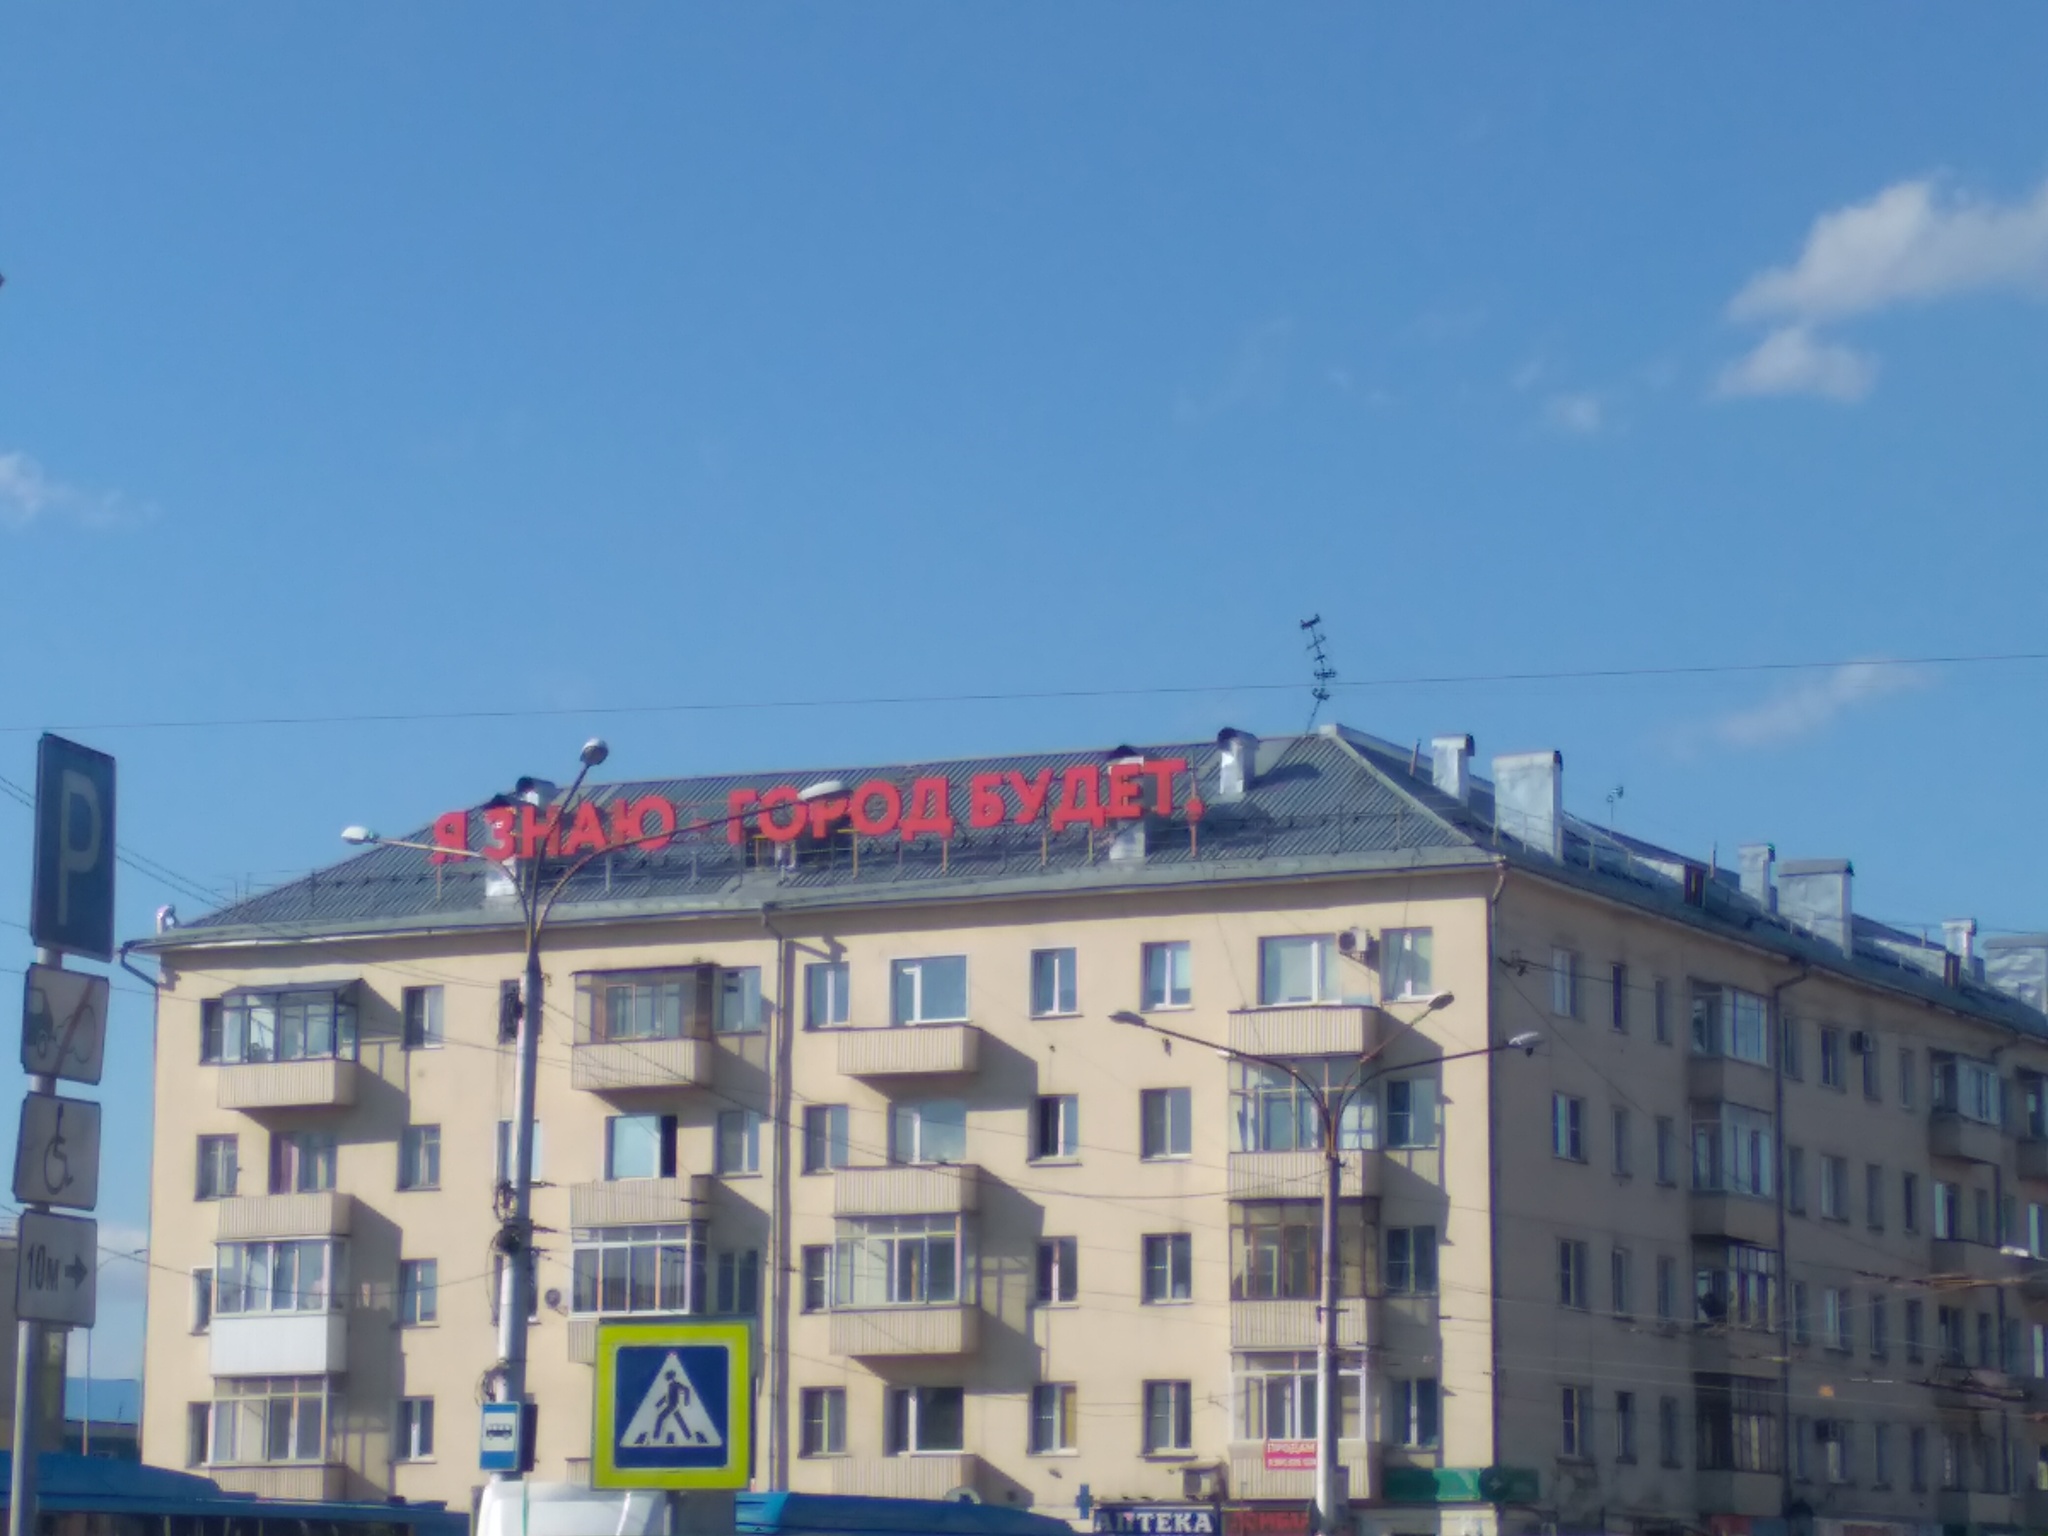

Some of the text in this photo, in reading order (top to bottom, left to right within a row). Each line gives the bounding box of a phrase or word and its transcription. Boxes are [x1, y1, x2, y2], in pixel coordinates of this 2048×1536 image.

[57, 769, 102, 926] P
[430, 811, 468, 864] Я
[483, 794, 676, 861] ЗНАЮ
[726, 776, 955, 846] ГОРОД
[1095, 1511, 1213, 1534] АПТЕКА
